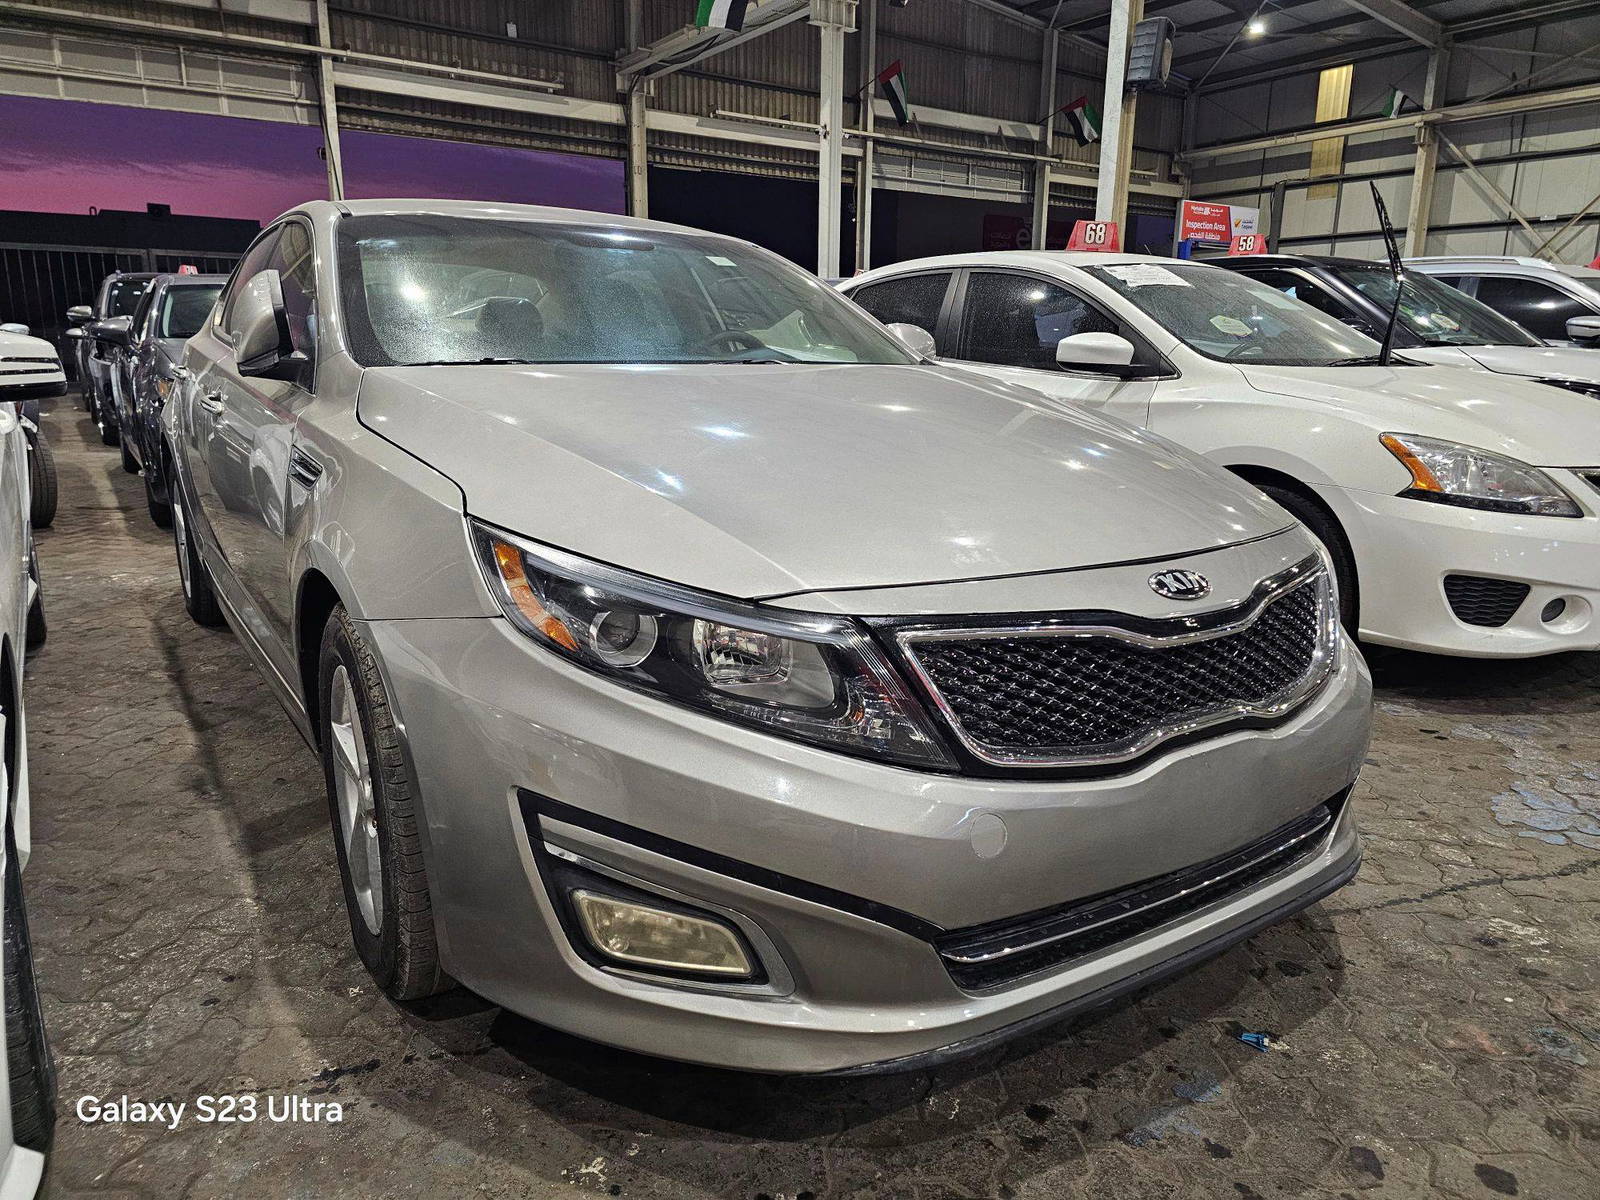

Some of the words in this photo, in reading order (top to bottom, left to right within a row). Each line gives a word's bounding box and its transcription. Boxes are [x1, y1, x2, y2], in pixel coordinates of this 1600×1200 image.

[1085, 223, 1106, 244] 68
[1186, 219, 1213, 230] Inspection
[1213, 222, 1226, 231] Area
[1238, 235, 1255, 251] 58
[1155, 570, 1208, 593] KIA
